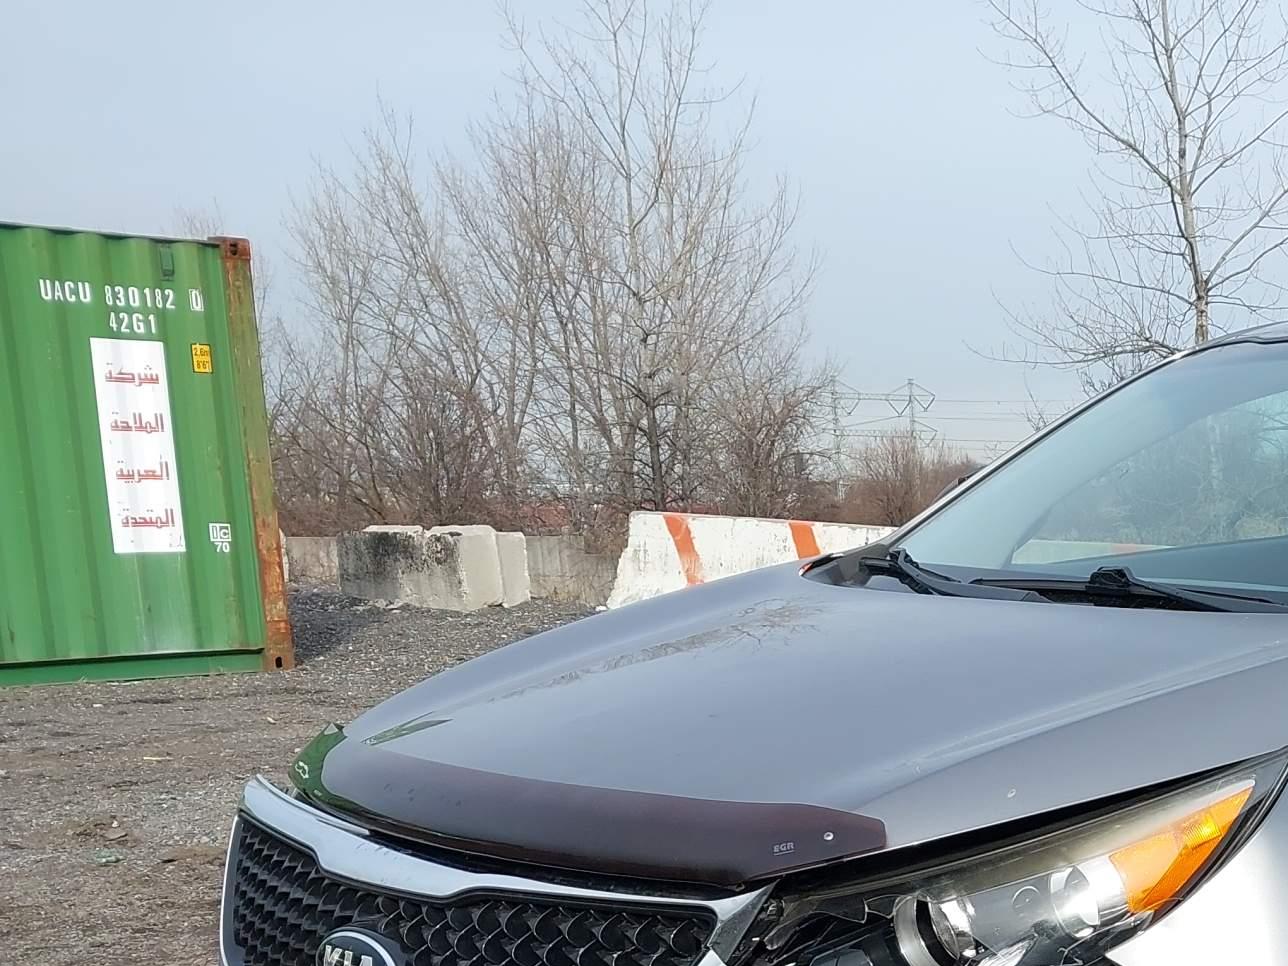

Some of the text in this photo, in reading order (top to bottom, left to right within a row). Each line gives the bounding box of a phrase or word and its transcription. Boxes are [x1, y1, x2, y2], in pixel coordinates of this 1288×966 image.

[39, 278, 92, 303] UACU
[104, 284, 176, 309] 830182
[109, 311, 157, 334] 42G1
[105, 362, 160, 387] شركة
[110, 411, 165, 434] الملاحة
[115, 460, 170, 484] العربية
[121, 508, 175, 529] المتحدة
[214, 541, 230, 552] 70
[773, 842, 794, 853] EGR
